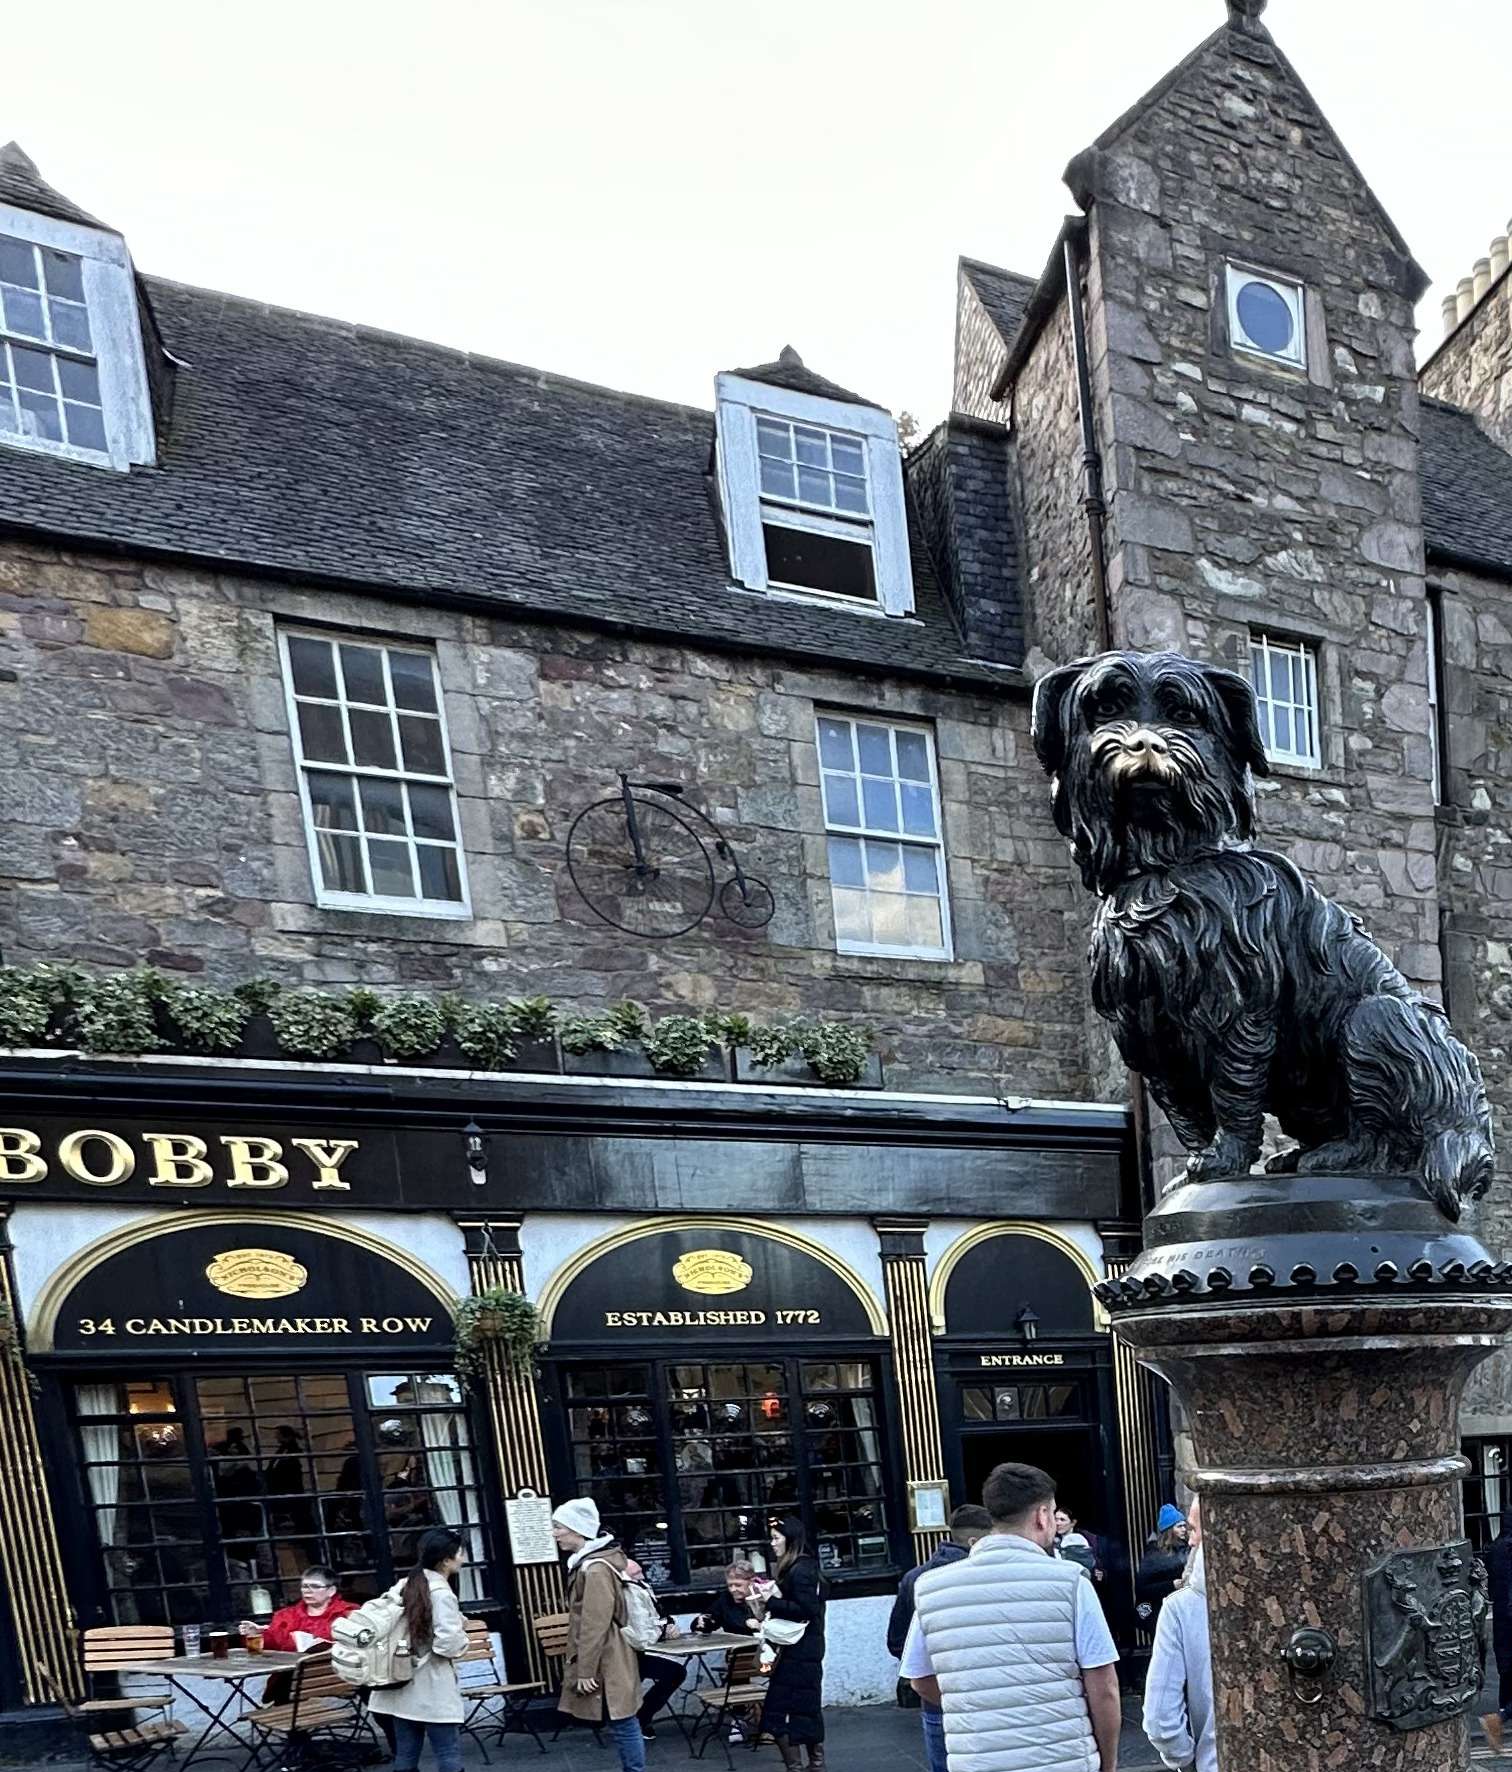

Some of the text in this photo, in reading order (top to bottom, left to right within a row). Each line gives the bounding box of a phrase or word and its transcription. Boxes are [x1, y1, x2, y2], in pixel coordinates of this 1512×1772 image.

[0, 1127, 360, 1191] BOBBY
[79, 1317, 433, 1335] 34 CANDLEMAKER ROW
[605, 1310, 821, 1328] ESTABLISHED 1772
[980, 1354, 1065, 1367] ENTRANCE
